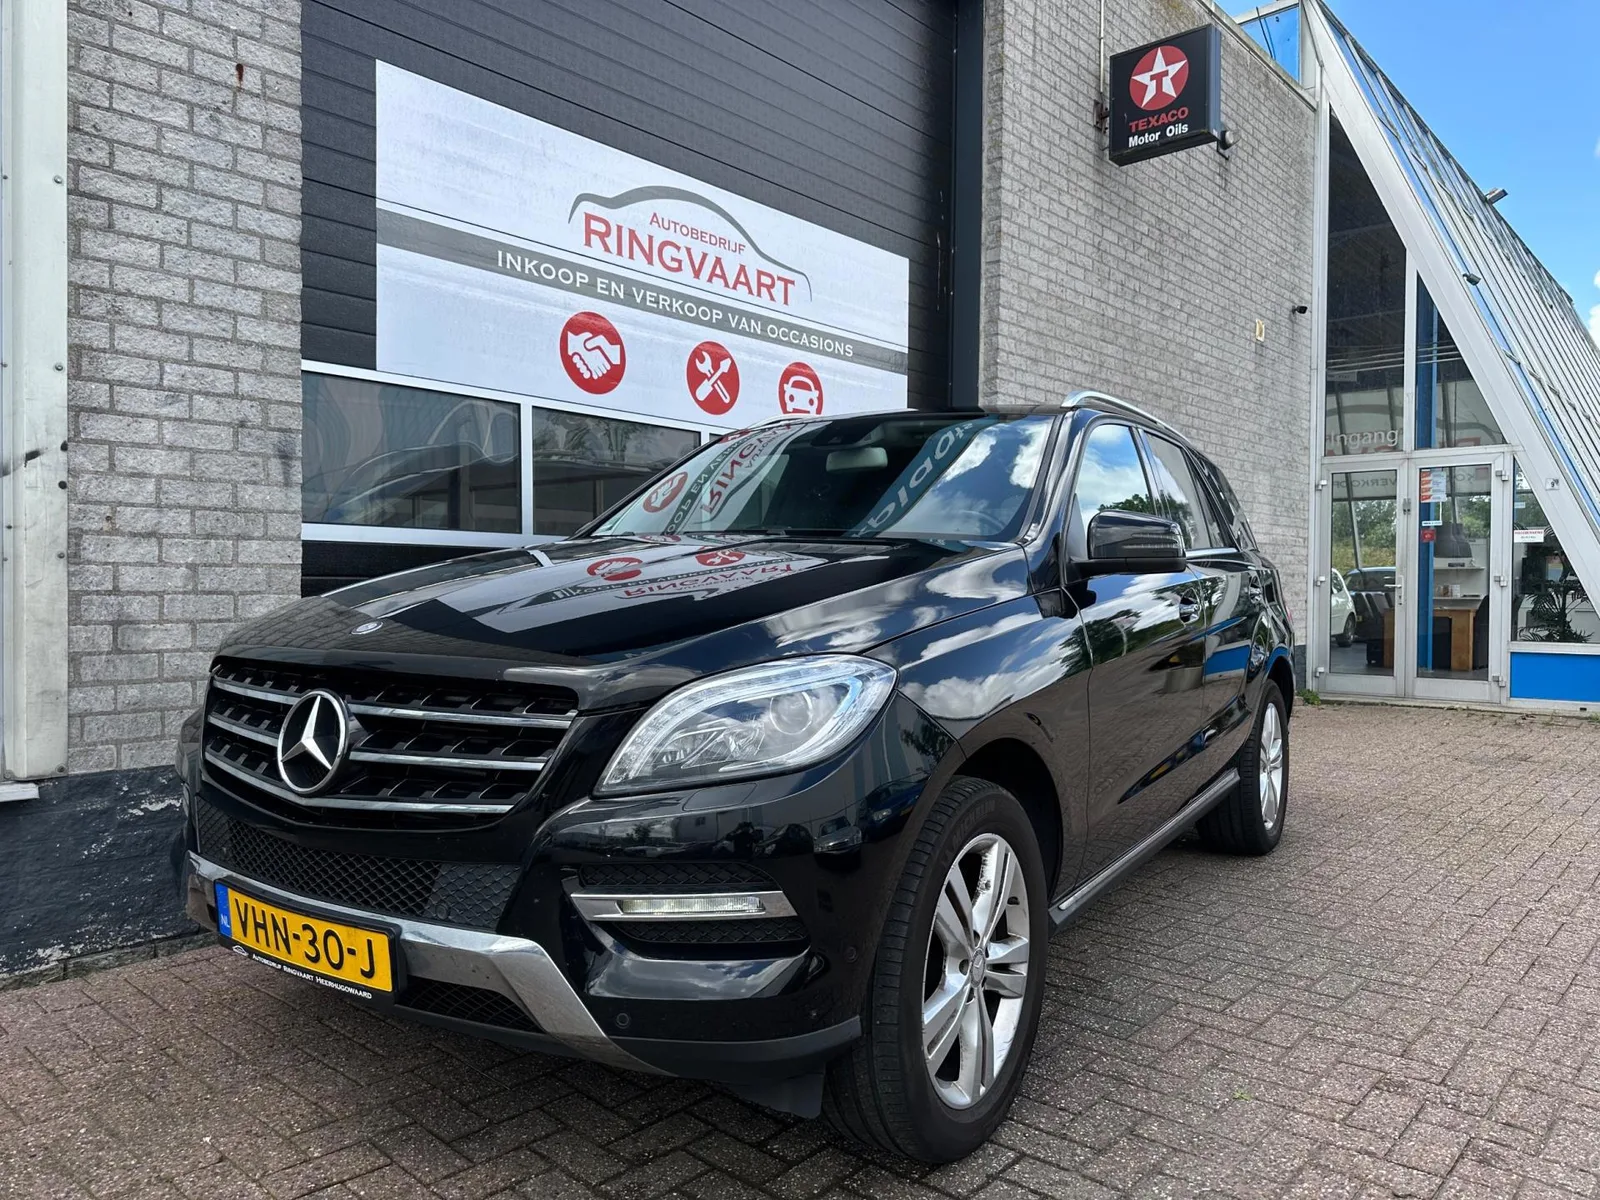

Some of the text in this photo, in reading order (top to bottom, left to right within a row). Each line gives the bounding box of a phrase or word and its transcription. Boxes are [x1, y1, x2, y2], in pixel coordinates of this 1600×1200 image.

[1128, 106, 1189, 133] TEXACO
[1128, 123, 1189, 148] Motor Oils
[583, 211, 796, 306] RINGVAART
[497, 250, 854, 358] INKOOP EN VERKOOP VAN OCCASIONS
[1331, 429, 1399, 448] Ingang
[220, 897, 376, 979] NL VHN-30-J
